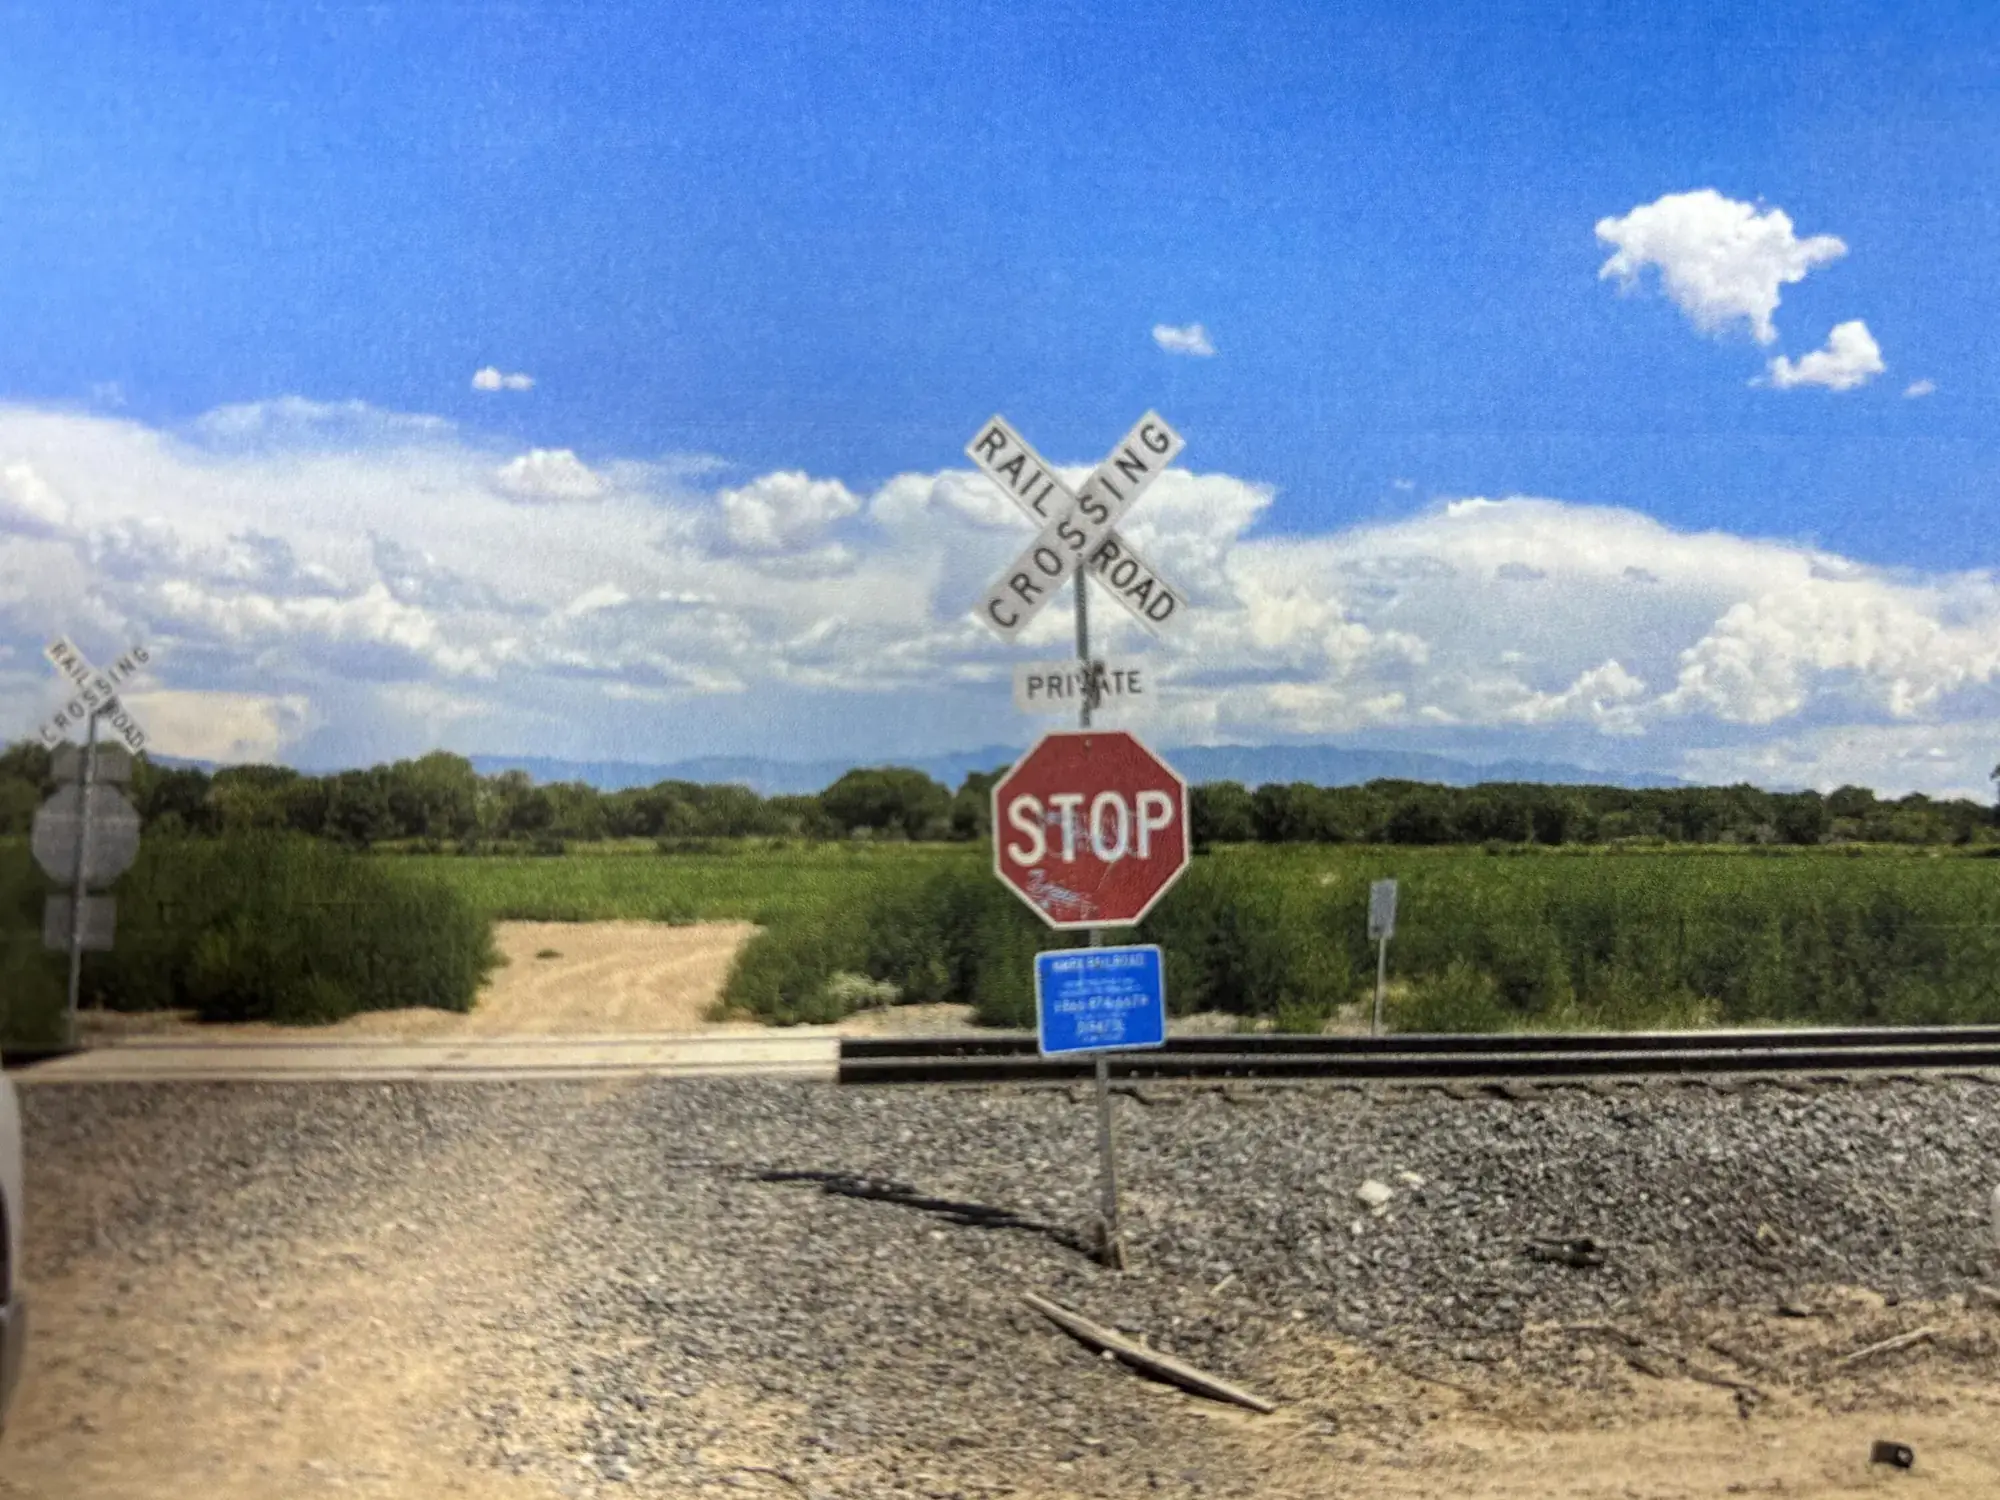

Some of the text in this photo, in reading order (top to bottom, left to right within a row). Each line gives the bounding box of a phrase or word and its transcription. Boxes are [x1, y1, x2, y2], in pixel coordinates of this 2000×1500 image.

[975, 427, 1055, 518] RAIL
[988, 424, 1170, 629] CROSSING
[1089, 539, 1174, 622] ROAD
[39, 647, 149, 743] CROSSING
[51, 643, 90, 685] RAIL
[1007, 791, 1174, 866] STOP
